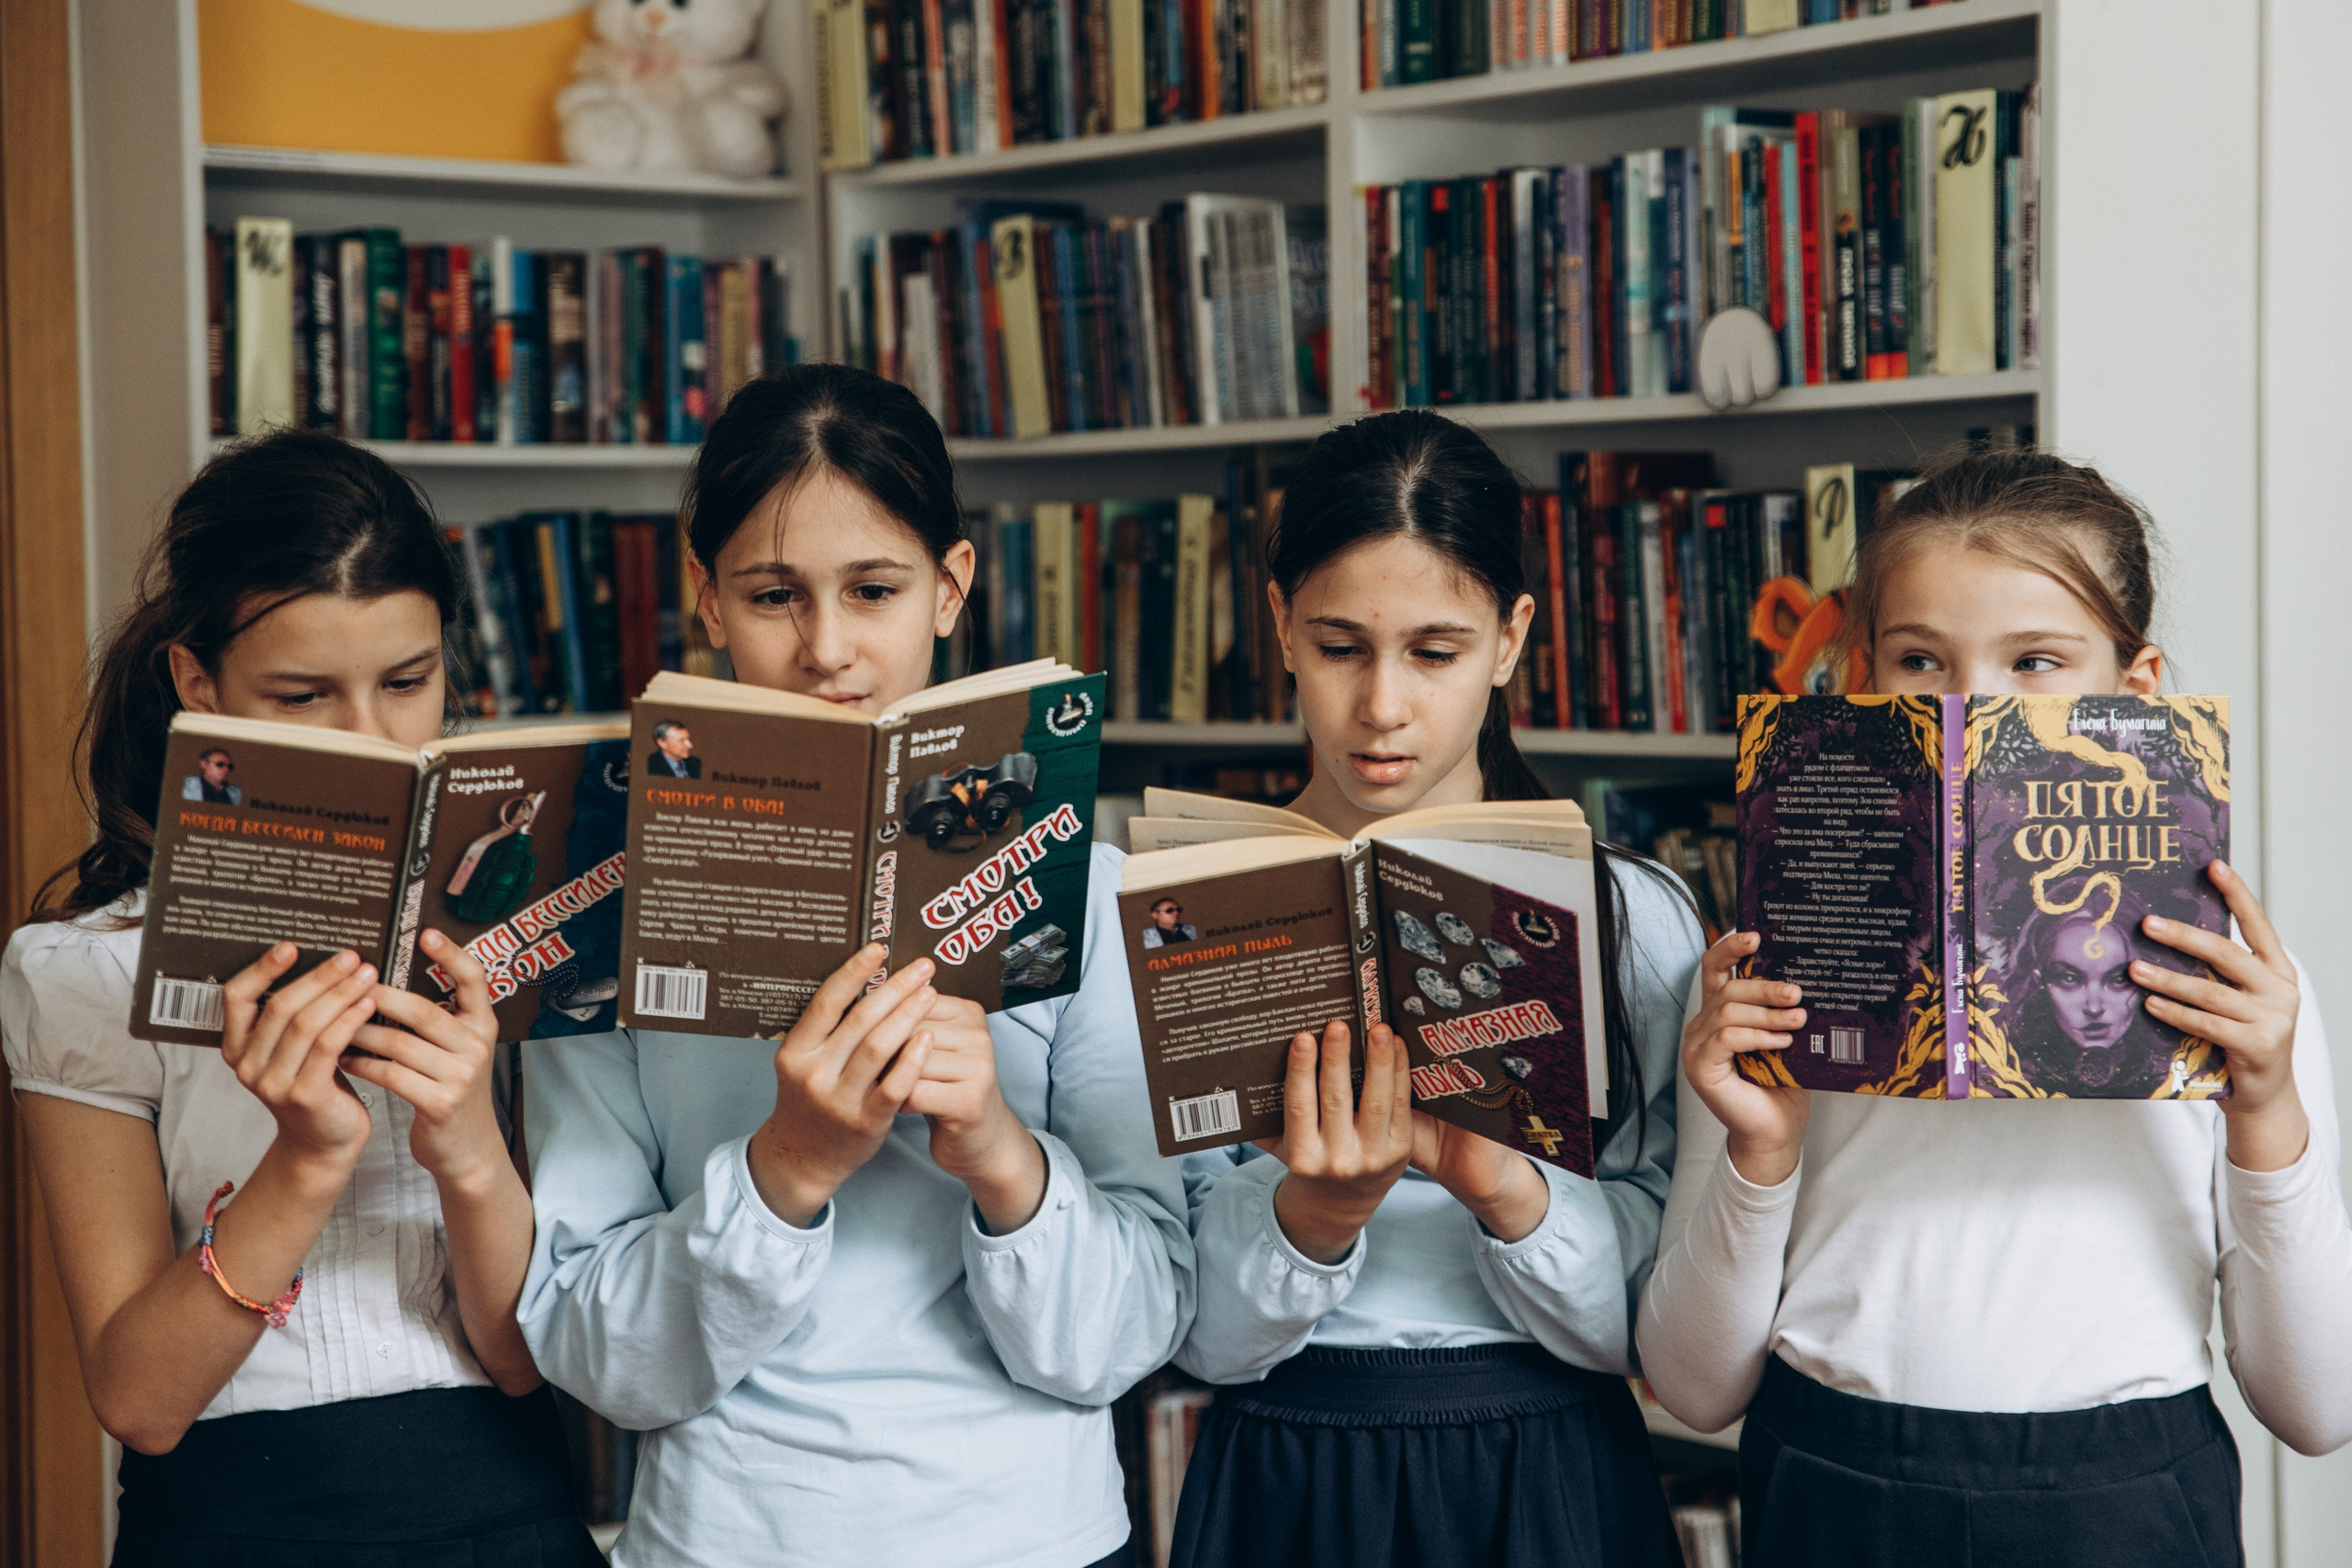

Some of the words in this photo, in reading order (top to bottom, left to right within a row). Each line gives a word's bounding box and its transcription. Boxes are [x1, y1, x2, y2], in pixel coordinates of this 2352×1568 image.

[910, 725, 965, 744] Виктор
[2073, 708, 2107, 732] Елена
[2109, 708, 2166, 738] Бумагина
[910, 739, 958, 758] Павлов
[447, 778, 524, 795] Сердюков
[449, 764, 514, 779] Николай
[646, 789, 717, 808] СМОТРИ
[741, 795, 785, 815] ОБА!
[1950, 761, 1964, 840] СОЛНЦЕ
[2023, 779, 2169, 819] ПЯТОЕ
[179, 812, 237, 832] КОГДА
[242, 819, 325, 843] БЕССИЛЕН
[333, 831, 386, 852] ЗАКОН
[2013, 823, 2183, 866] СОЛНЦЕ
[922, 804, 1083, 929] СМОТРИ
[1378, 858, 1433, 887] Николай
[1378, 871, 1444, 902] Сердюков
[1951, 842, 1965, 912] ПЯТОЕ
[870, 850, 898, 941] СМОТРИ
[934, 876, 1043, 965] ОБА!
[1148, 944, 1238, 972] АЛМАЗНАЯ
[1244, 934, 1294, 953] ПЫЛЬ
[1419, 1000, 1563, 1056] АЛМАЗНАЯ
[1411, 1058, 1486, 1100] ПЫЛЬ
